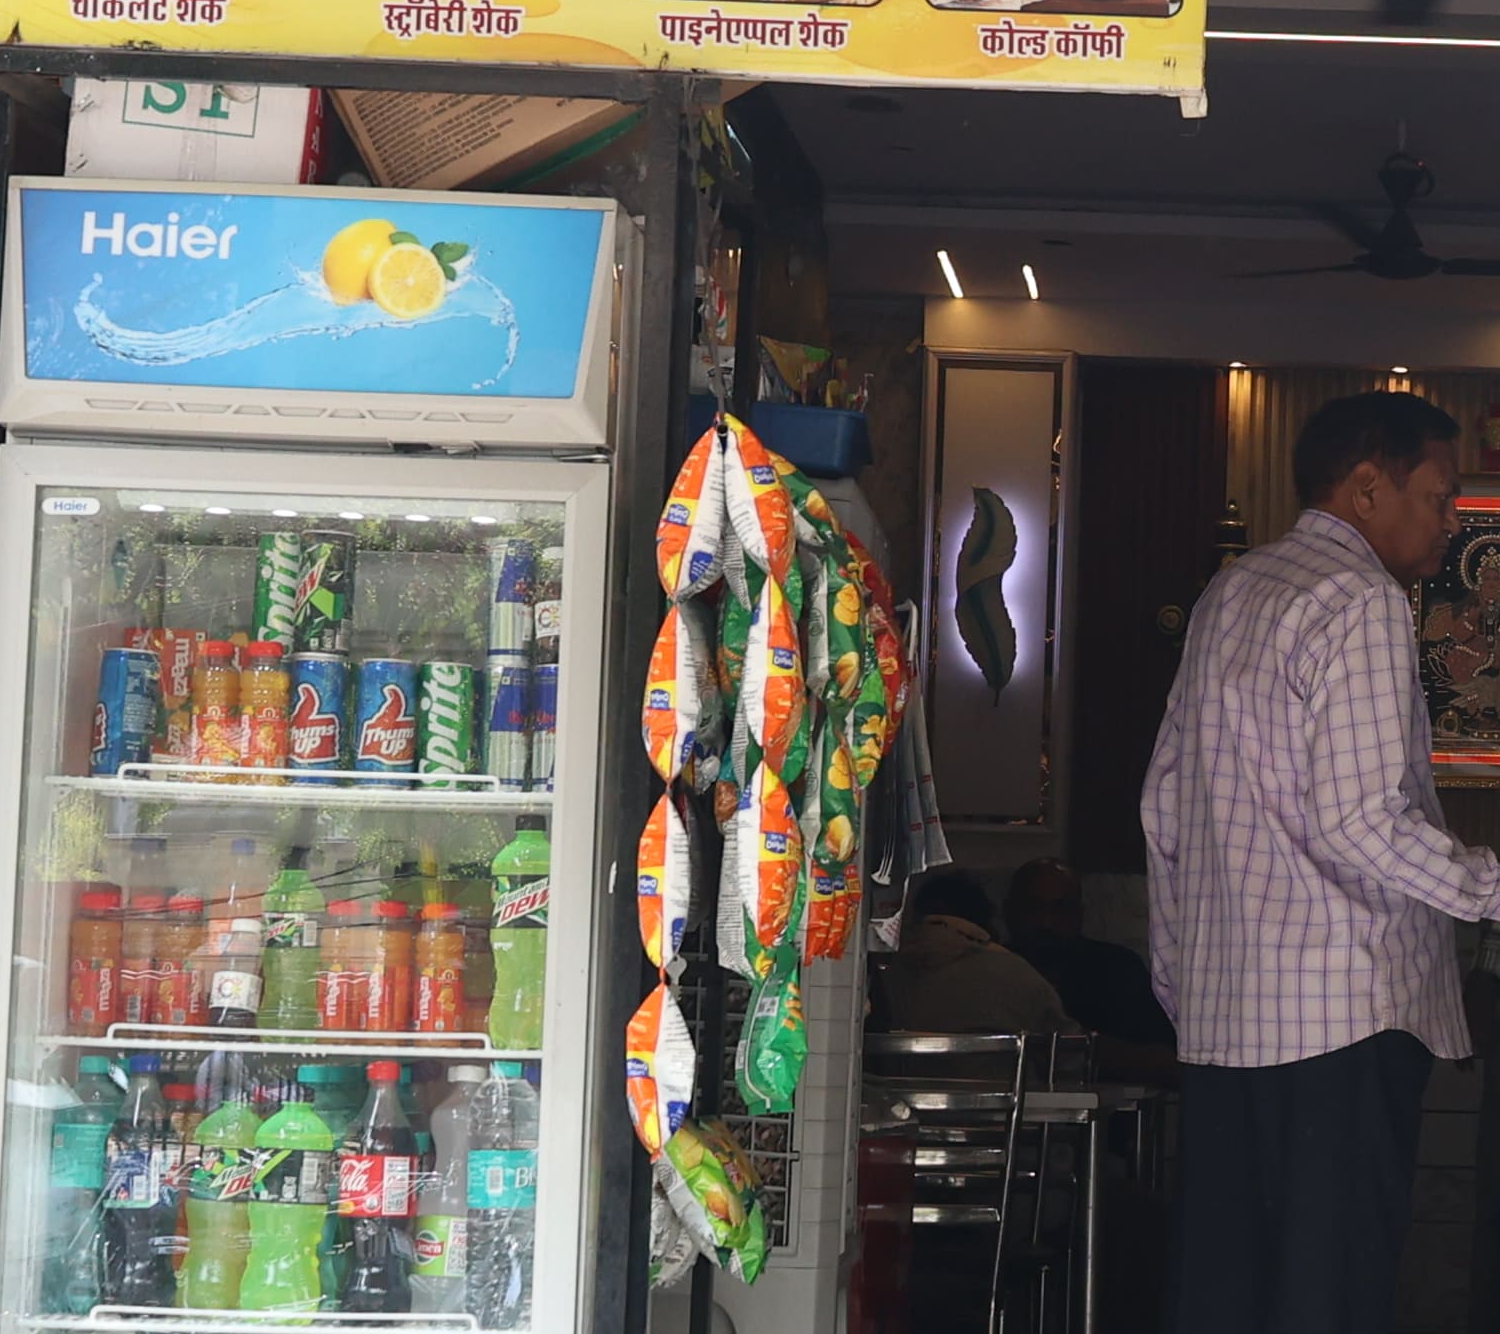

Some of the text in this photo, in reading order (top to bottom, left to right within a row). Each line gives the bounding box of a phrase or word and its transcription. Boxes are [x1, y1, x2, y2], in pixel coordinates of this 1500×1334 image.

[472, 3, 523, 37] शेक
[799, 14, 849, 49] शेक
[980, 20, 1126, 61] कोल्ड कॉफी
[80, 210, 238, 260] Haier
[52, 498, 89, 514] Haier
